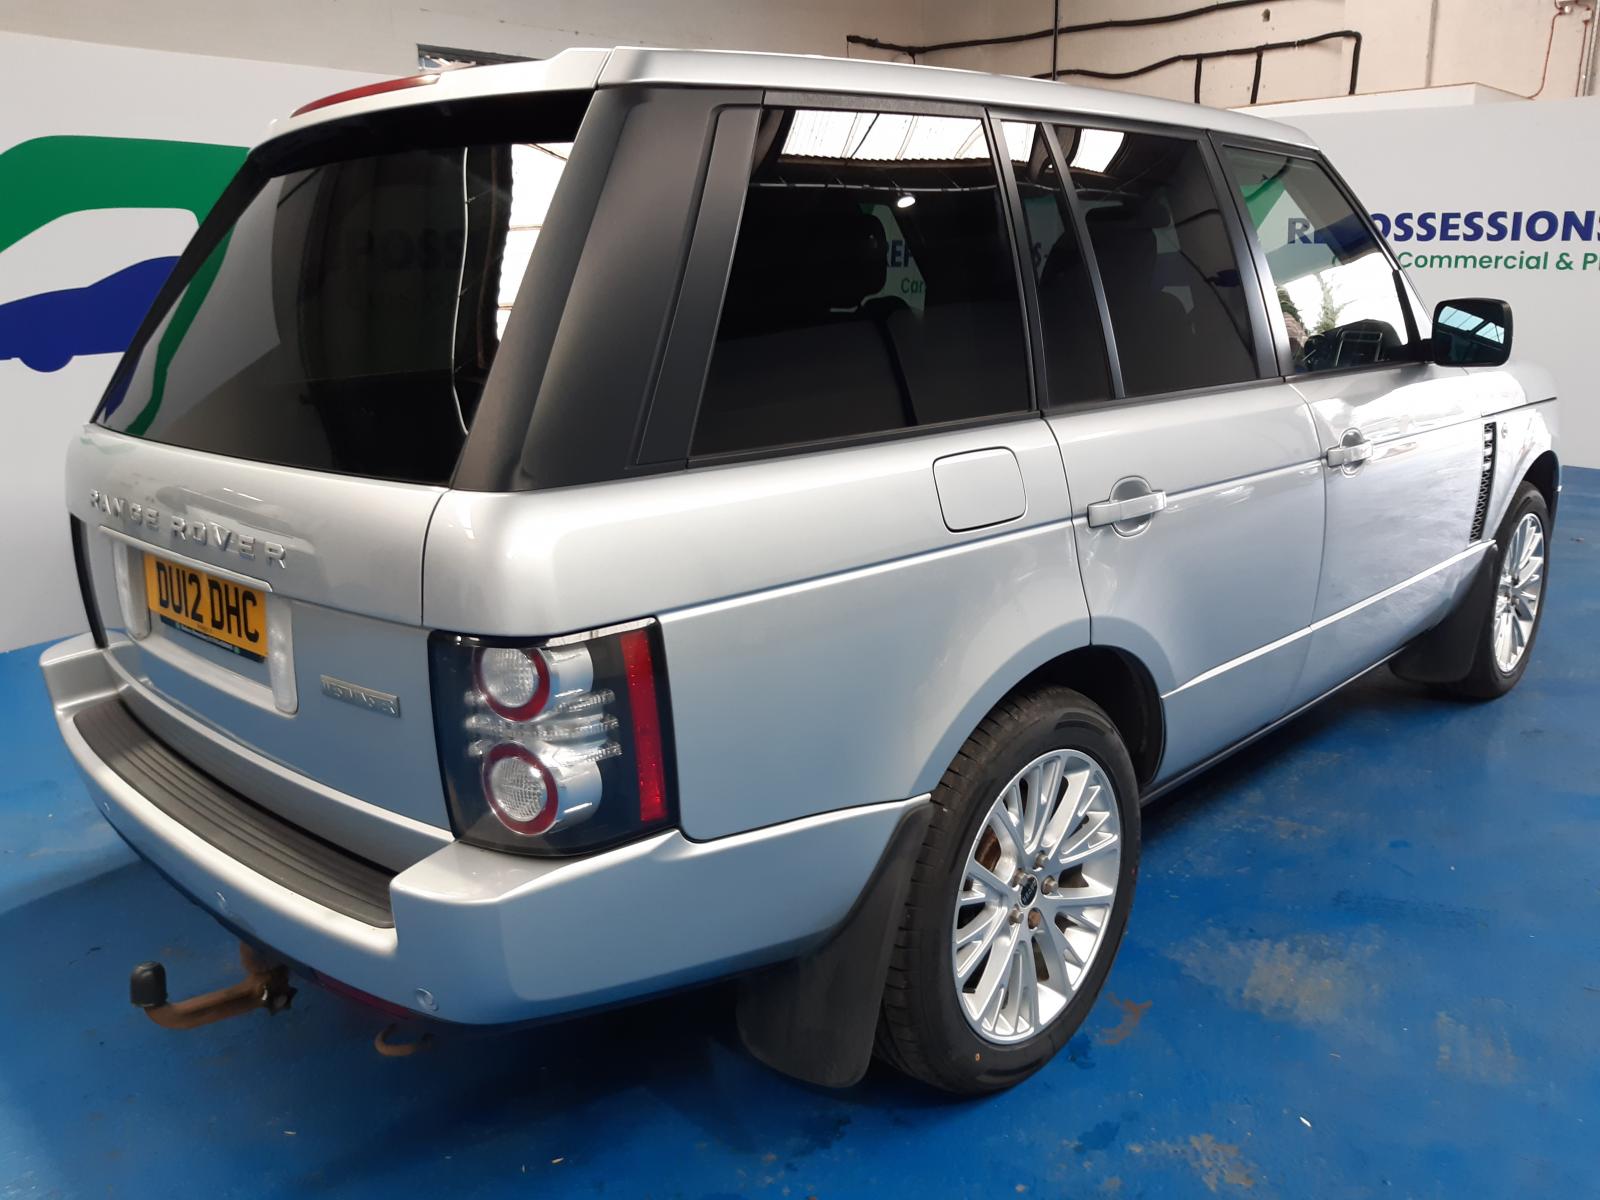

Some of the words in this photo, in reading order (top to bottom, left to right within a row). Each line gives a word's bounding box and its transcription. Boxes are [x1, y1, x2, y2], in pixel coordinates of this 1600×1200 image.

[1398, 250, 1548, 270] Commercial
[1555, 252, 1574, 270] &
[89, 488, 160, 531] RANGE
[171, 515, 287, 569] ROVER
[156, 560, 203, 624] DU12
[207, 578, 259, 643] DHC
